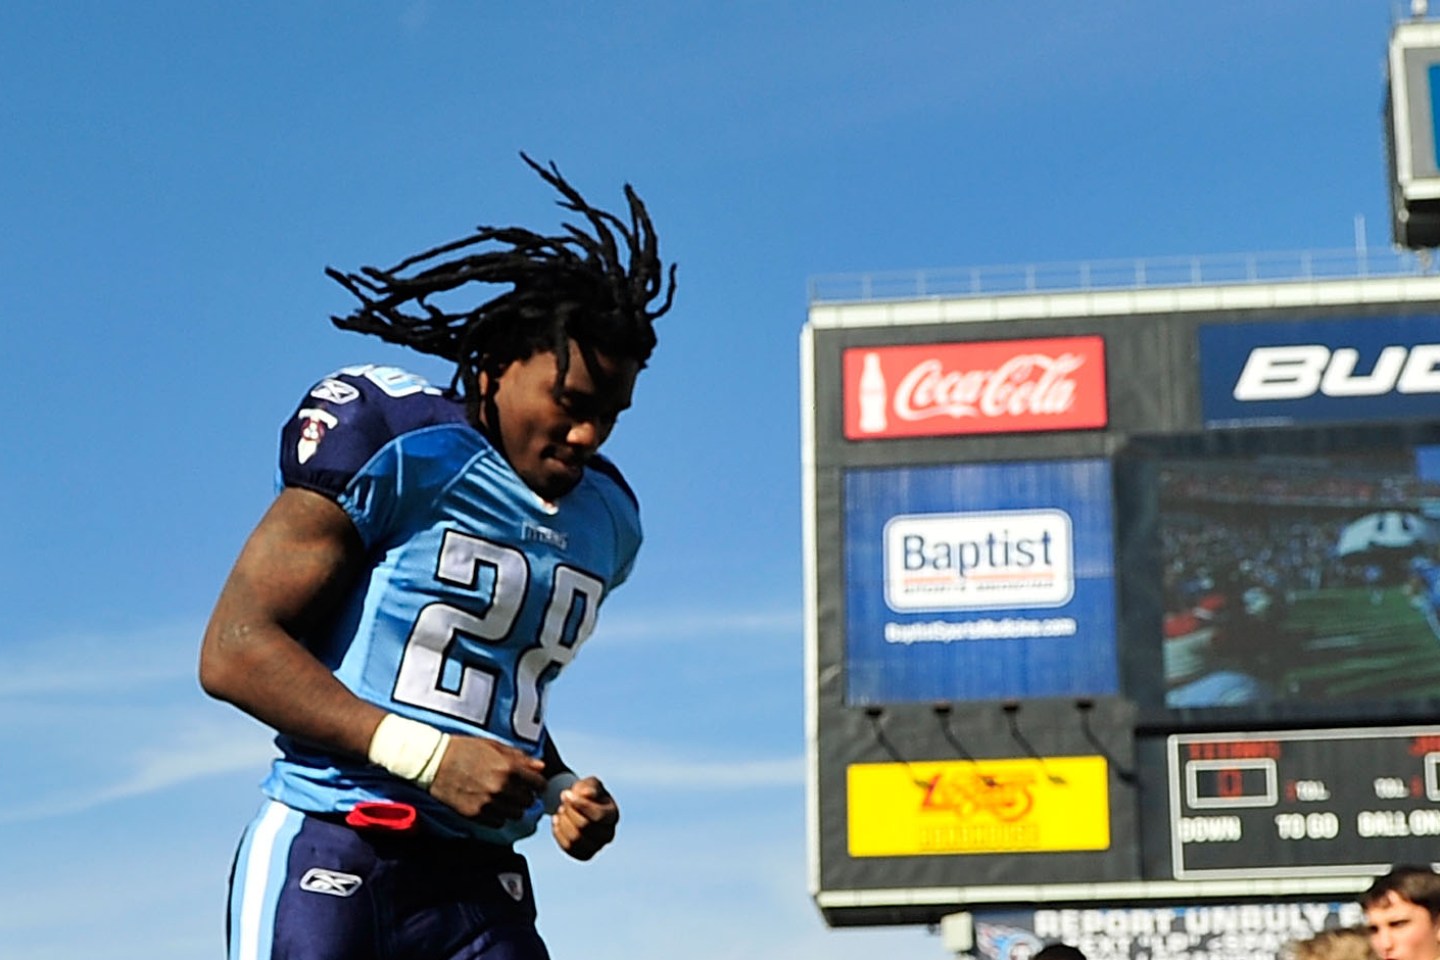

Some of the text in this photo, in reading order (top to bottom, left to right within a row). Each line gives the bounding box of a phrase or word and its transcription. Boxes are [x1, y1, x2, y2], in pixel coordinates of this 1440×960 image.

[902, 529, 1054, 578] Baptist
[391, 527, 607, 744] 28
[1178, 815, 1242, 843] DOWN
[1034, 908, 1176, 937] REPORT
